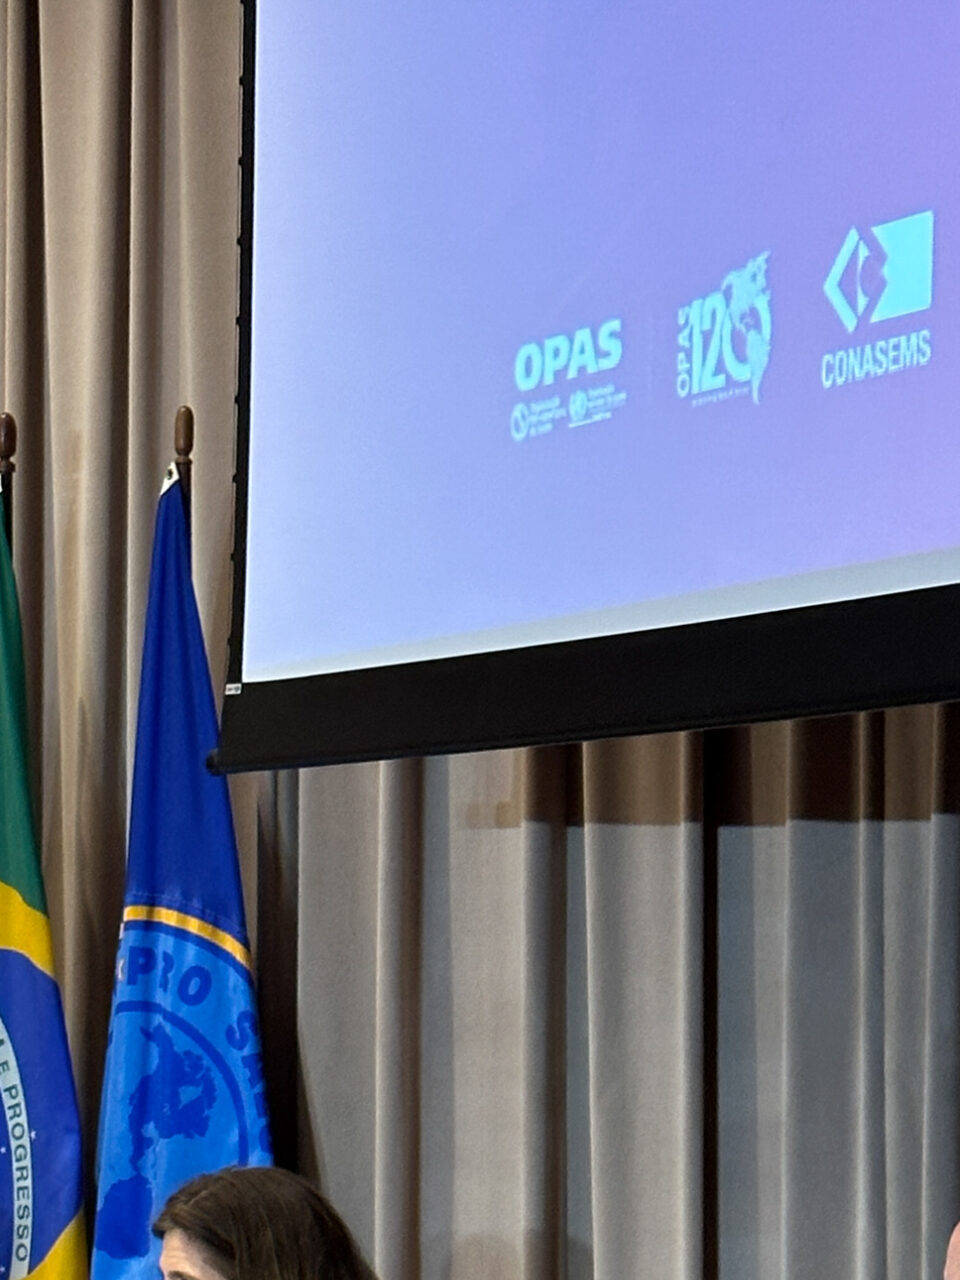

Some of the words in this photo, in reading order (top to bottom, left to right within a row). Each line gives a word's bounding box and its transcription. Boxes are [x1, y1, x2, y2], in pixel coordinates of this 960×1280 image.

[514, 319, 622, 392] OPAS
[821, 330, 931, 389] CONASEMS
[3, 1083, 29, 1262] PROGRESSO
